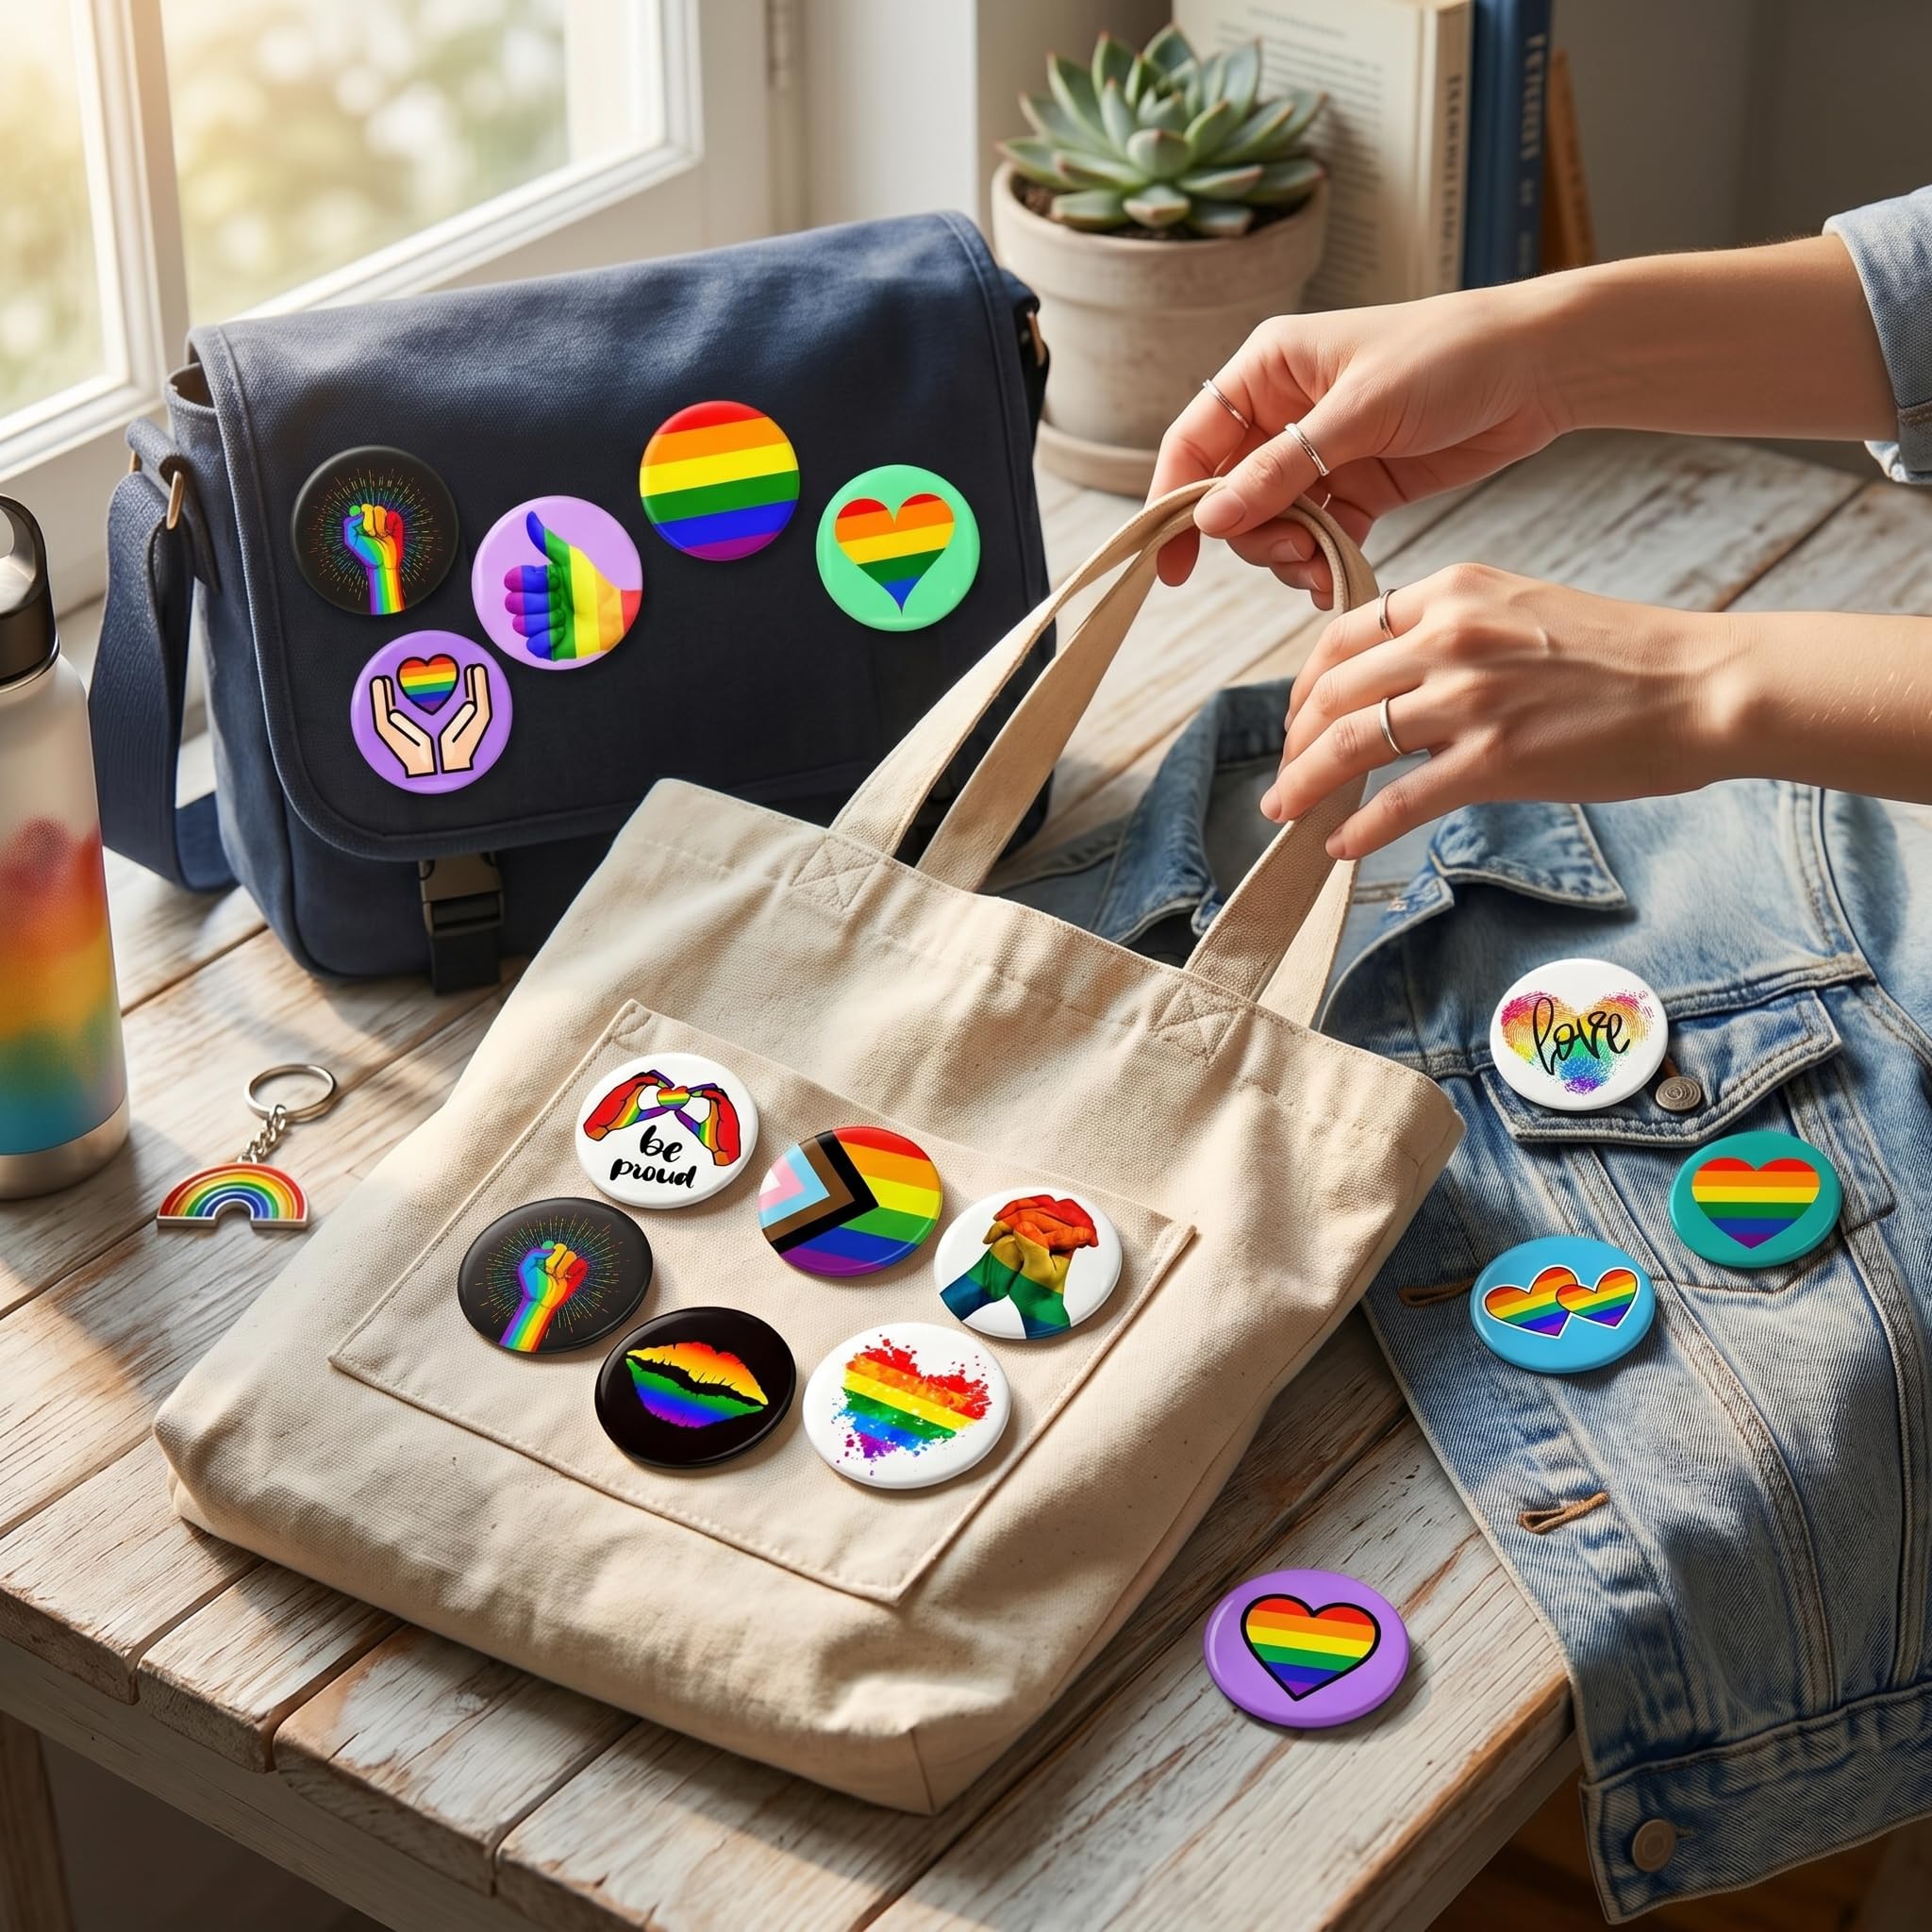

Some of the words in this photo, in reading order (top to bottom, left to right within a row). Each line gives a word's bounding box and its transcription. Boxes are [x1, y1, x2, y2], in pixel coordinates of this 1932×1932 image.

[1532, 997, 1630, 1075] love
[640, 1124, 683, 1162] be
[609, 1158, 697, 1189] proud
